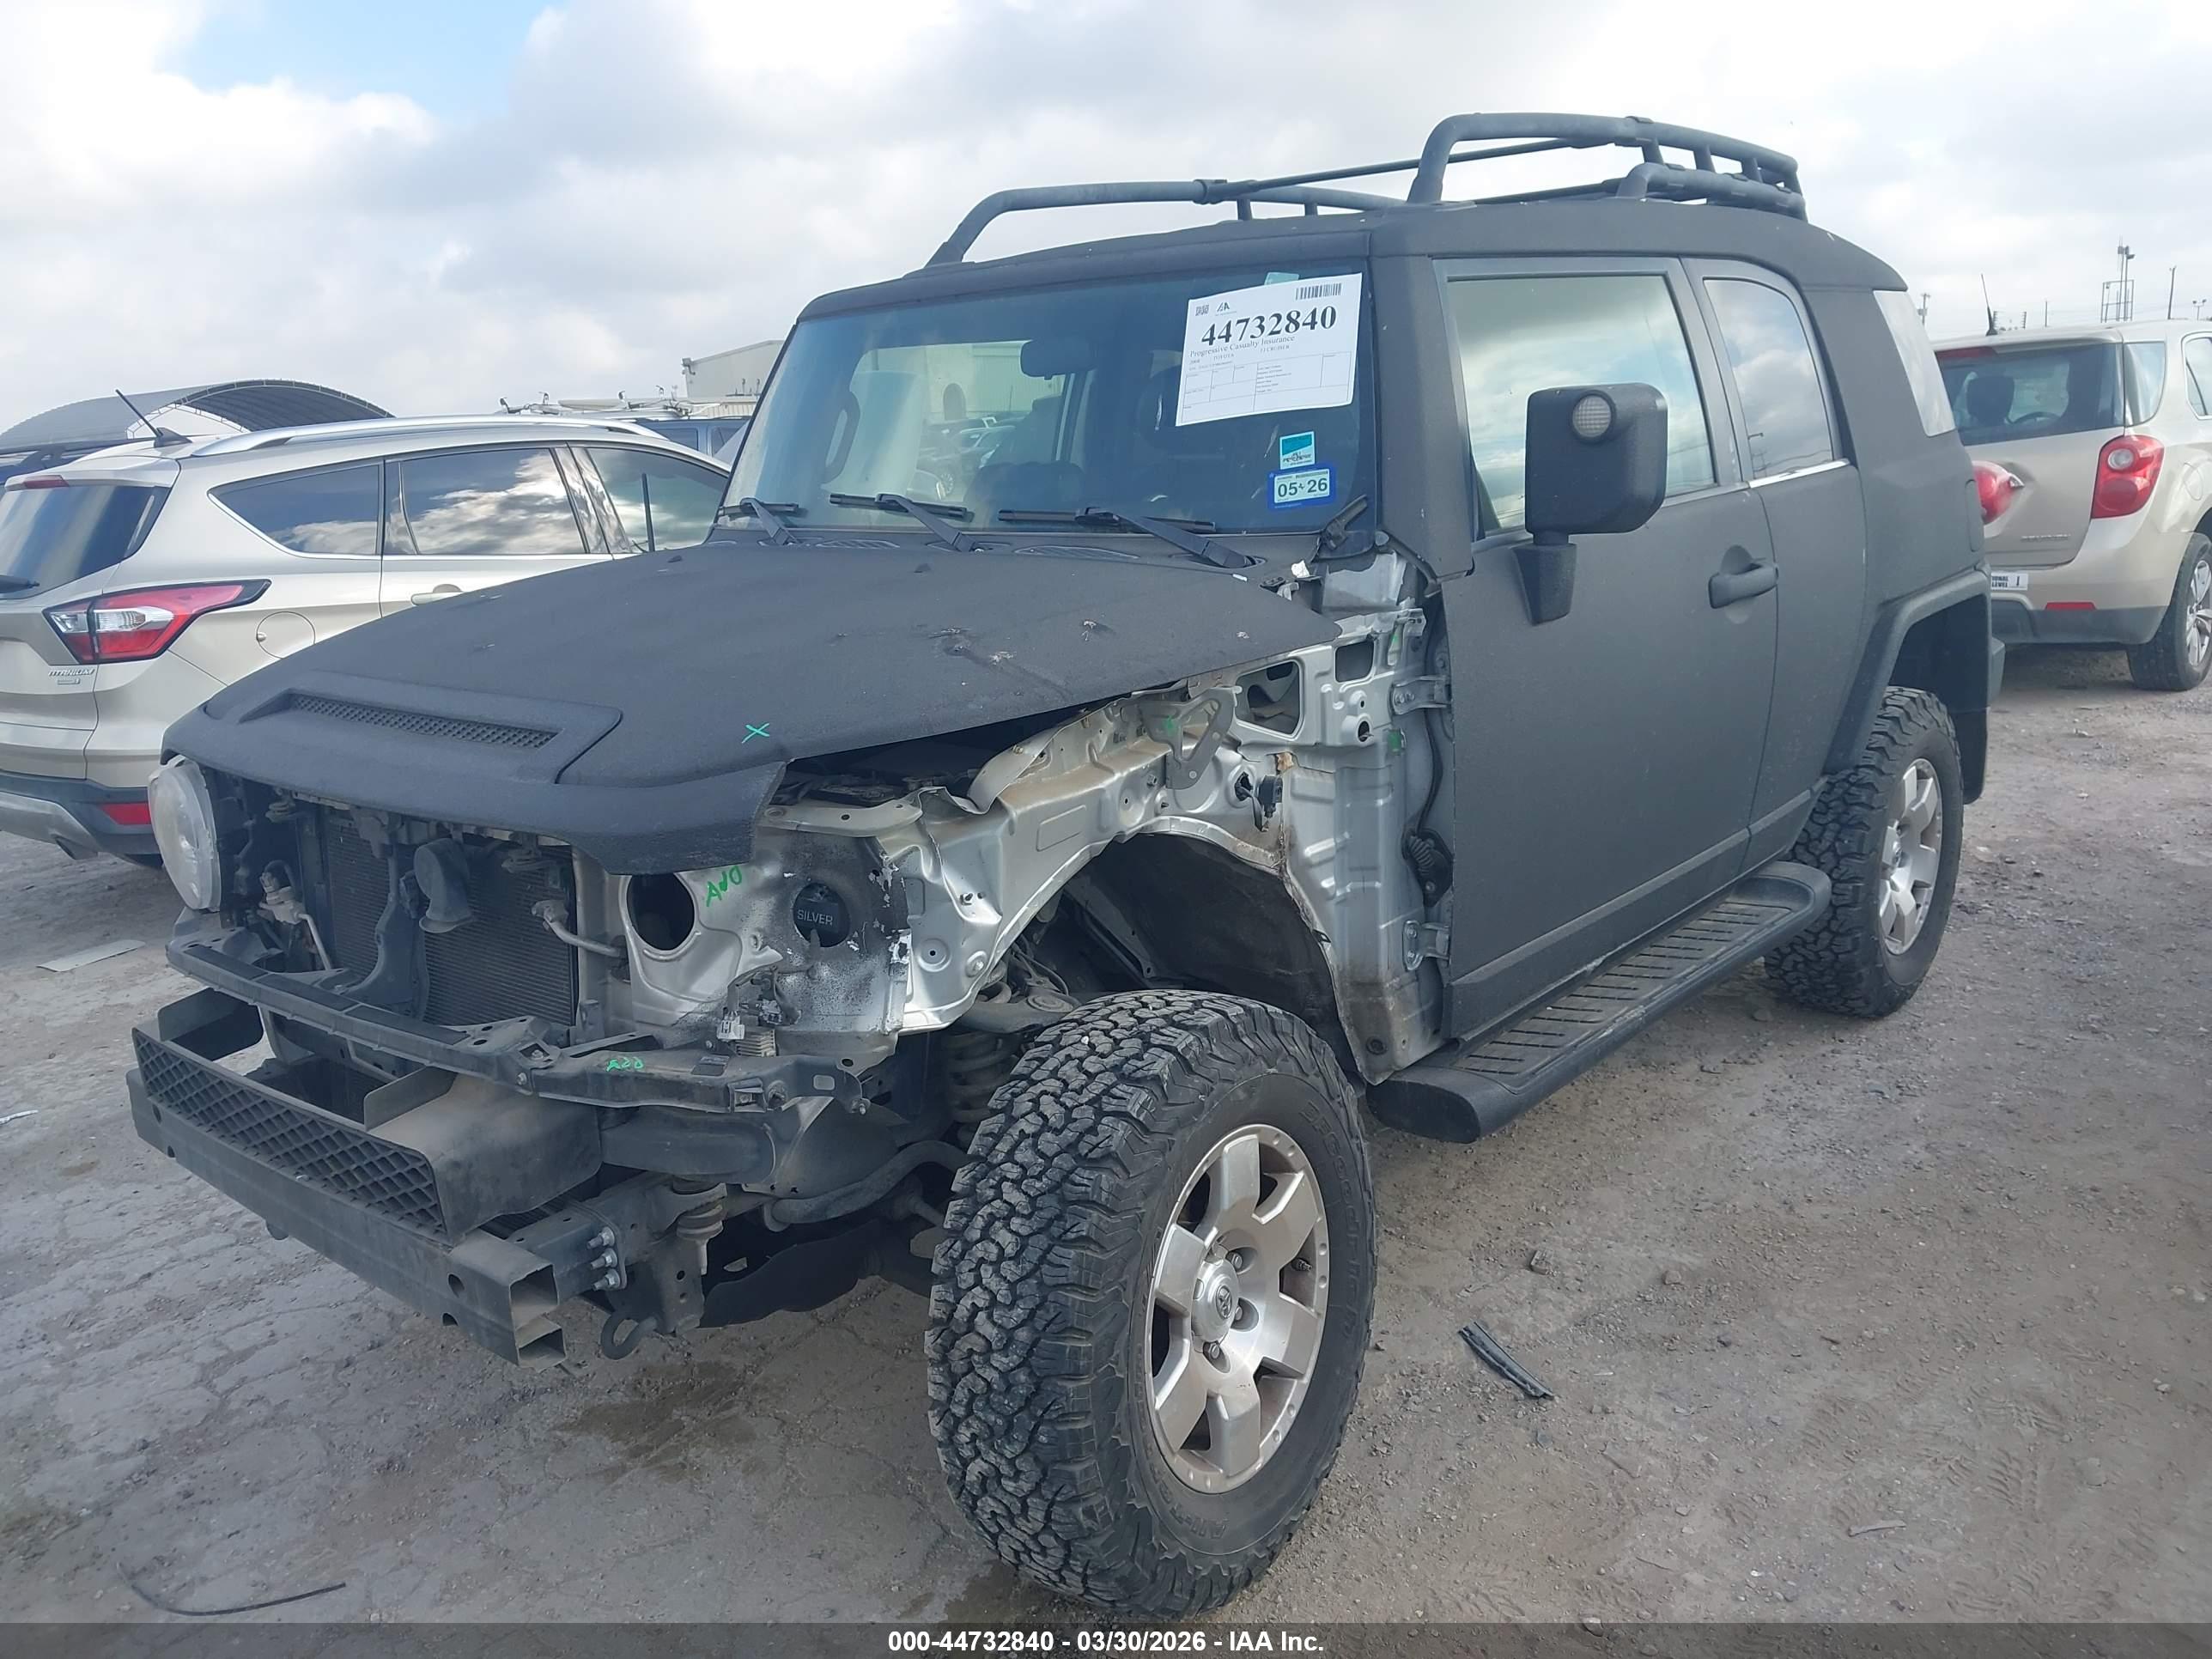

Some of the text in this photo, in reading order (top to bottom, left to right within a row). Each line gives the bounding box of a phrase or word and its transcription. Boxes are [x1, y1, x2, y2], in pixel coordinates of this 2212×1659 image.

[1201, 306, 1337, 346] 44732840
[1190, 335, 1296, 358] Progressive Casualty Insurance
[1278, 477, 1328, 498] 05 26
[797, 908, 833, 927] SILVER
